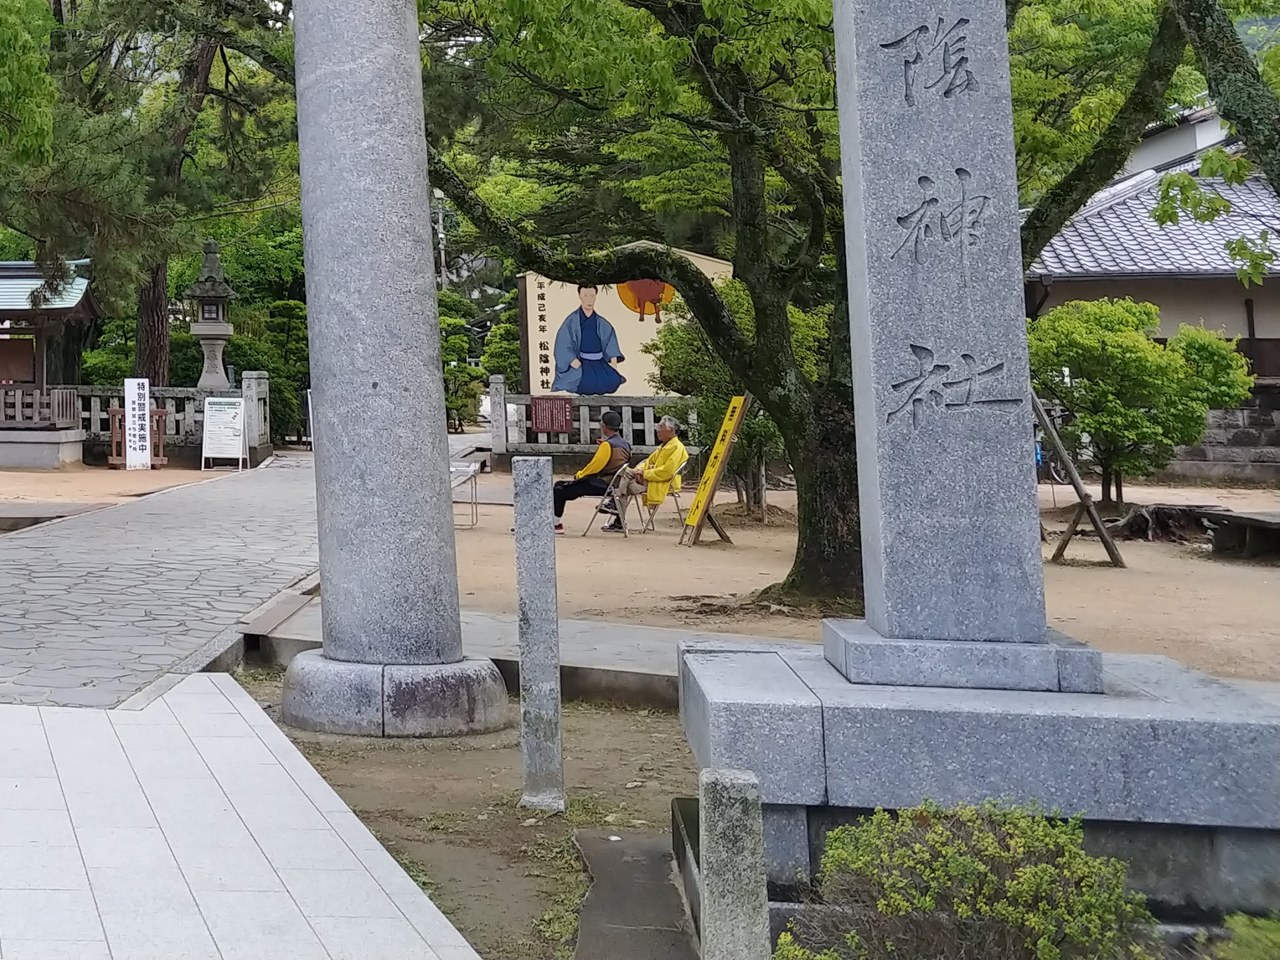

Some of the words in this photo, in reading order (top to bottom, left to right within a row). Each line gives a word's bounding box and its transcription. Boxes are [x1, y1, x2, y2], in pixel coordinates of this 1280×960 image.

[539, 341, 550, 390] 松陰神社
[137, 382, 147, 453] 特別警戒実施中
